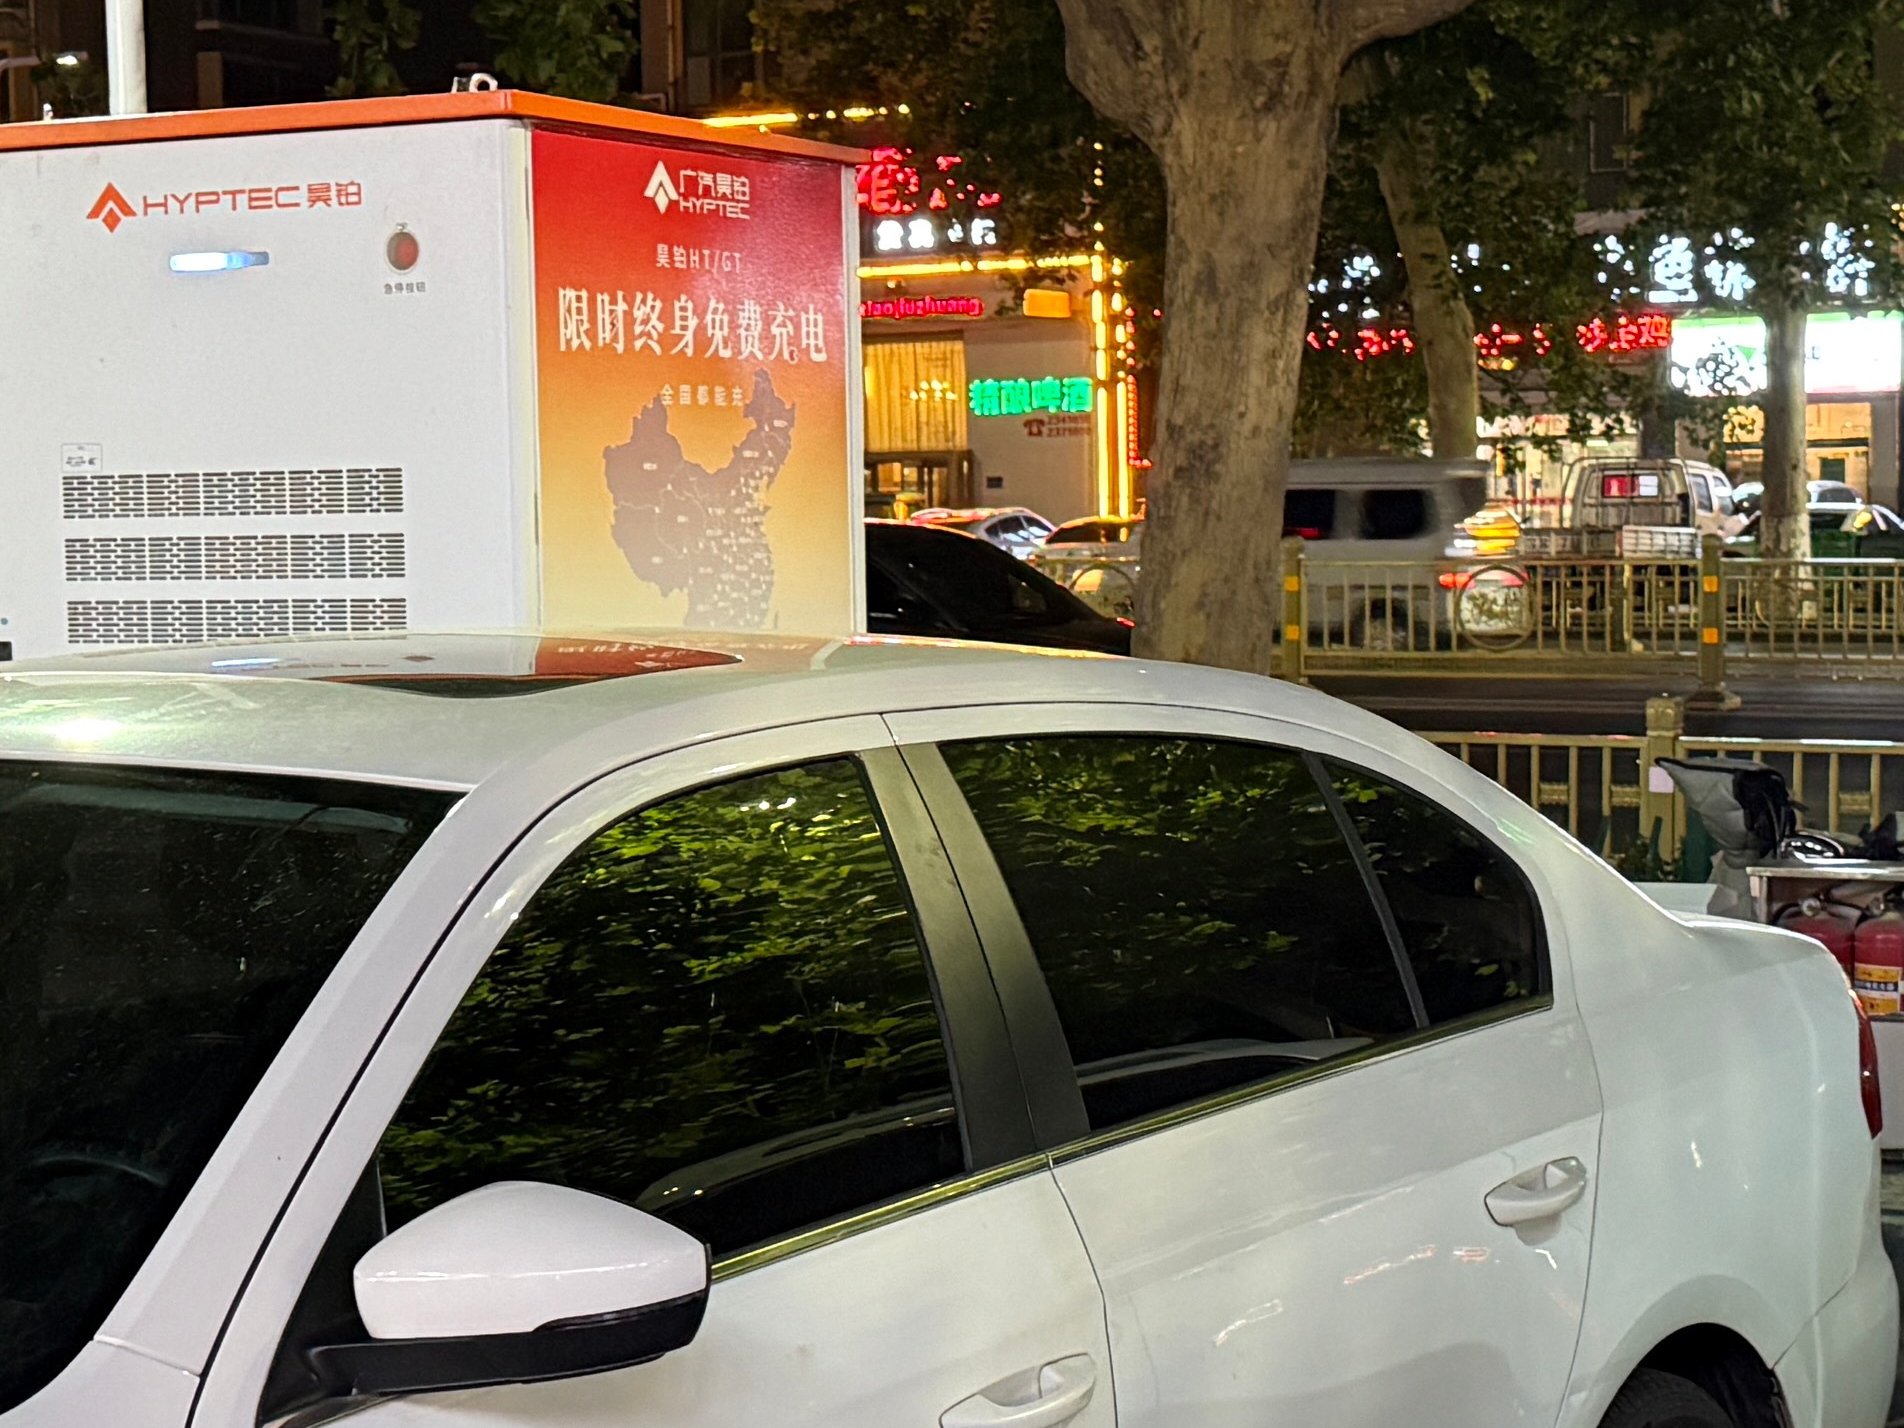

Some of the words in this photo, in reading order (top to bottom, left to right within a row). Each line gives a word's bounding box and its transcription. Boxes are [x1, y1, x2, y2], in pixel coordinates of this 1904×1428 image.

[143, 185, 300, 216] HYPTEC
[307, 180, 363, 208] 昊铂
[679, 169, 750, 200] 广汽昊铂
[679, 198, 750, 220] HYPTEC
[656, 243, 742, 273] 昊铂HT/GT
[557, 286, 828, 363] 限时终身免费充电
[969, 376, 1093, 416] 精酿啤酒
